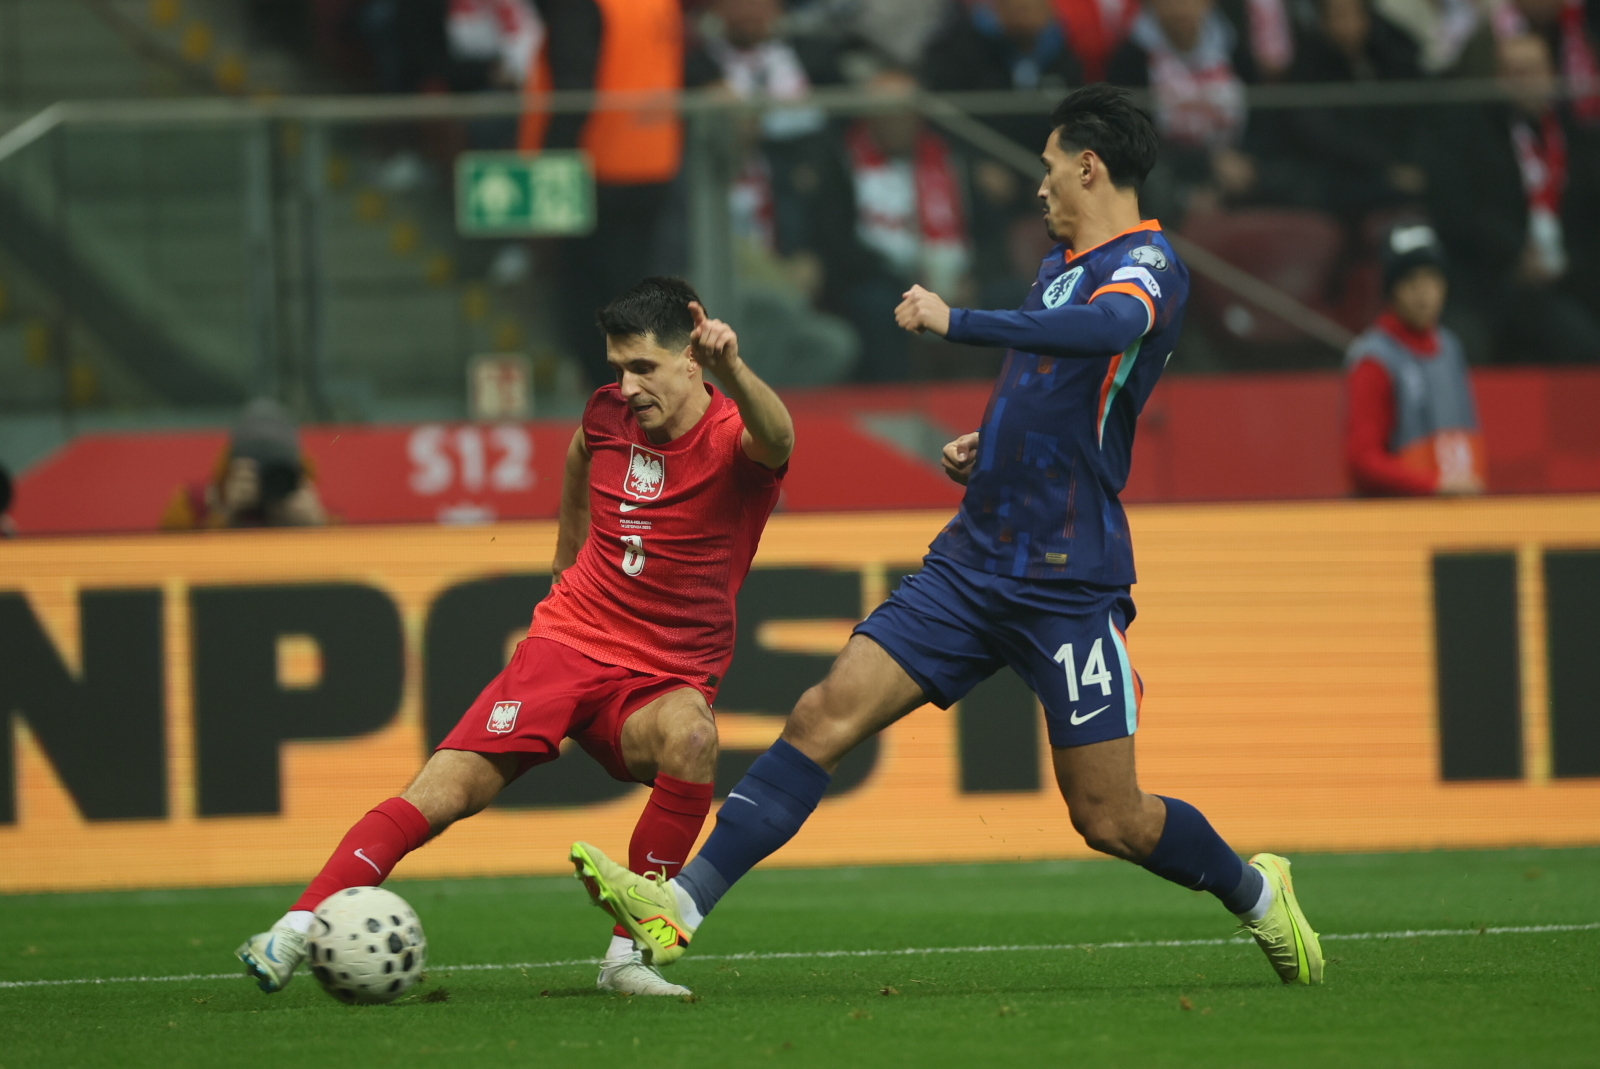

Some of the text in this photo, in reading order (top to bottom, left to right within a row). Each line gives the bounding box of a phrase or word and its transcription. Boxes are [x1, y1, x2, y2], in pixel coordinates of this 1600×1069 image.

[406, 422, 536, 493] S12
[0, 564, 1043, 826] NPS
[1053, 637, 1112, 702] 14
